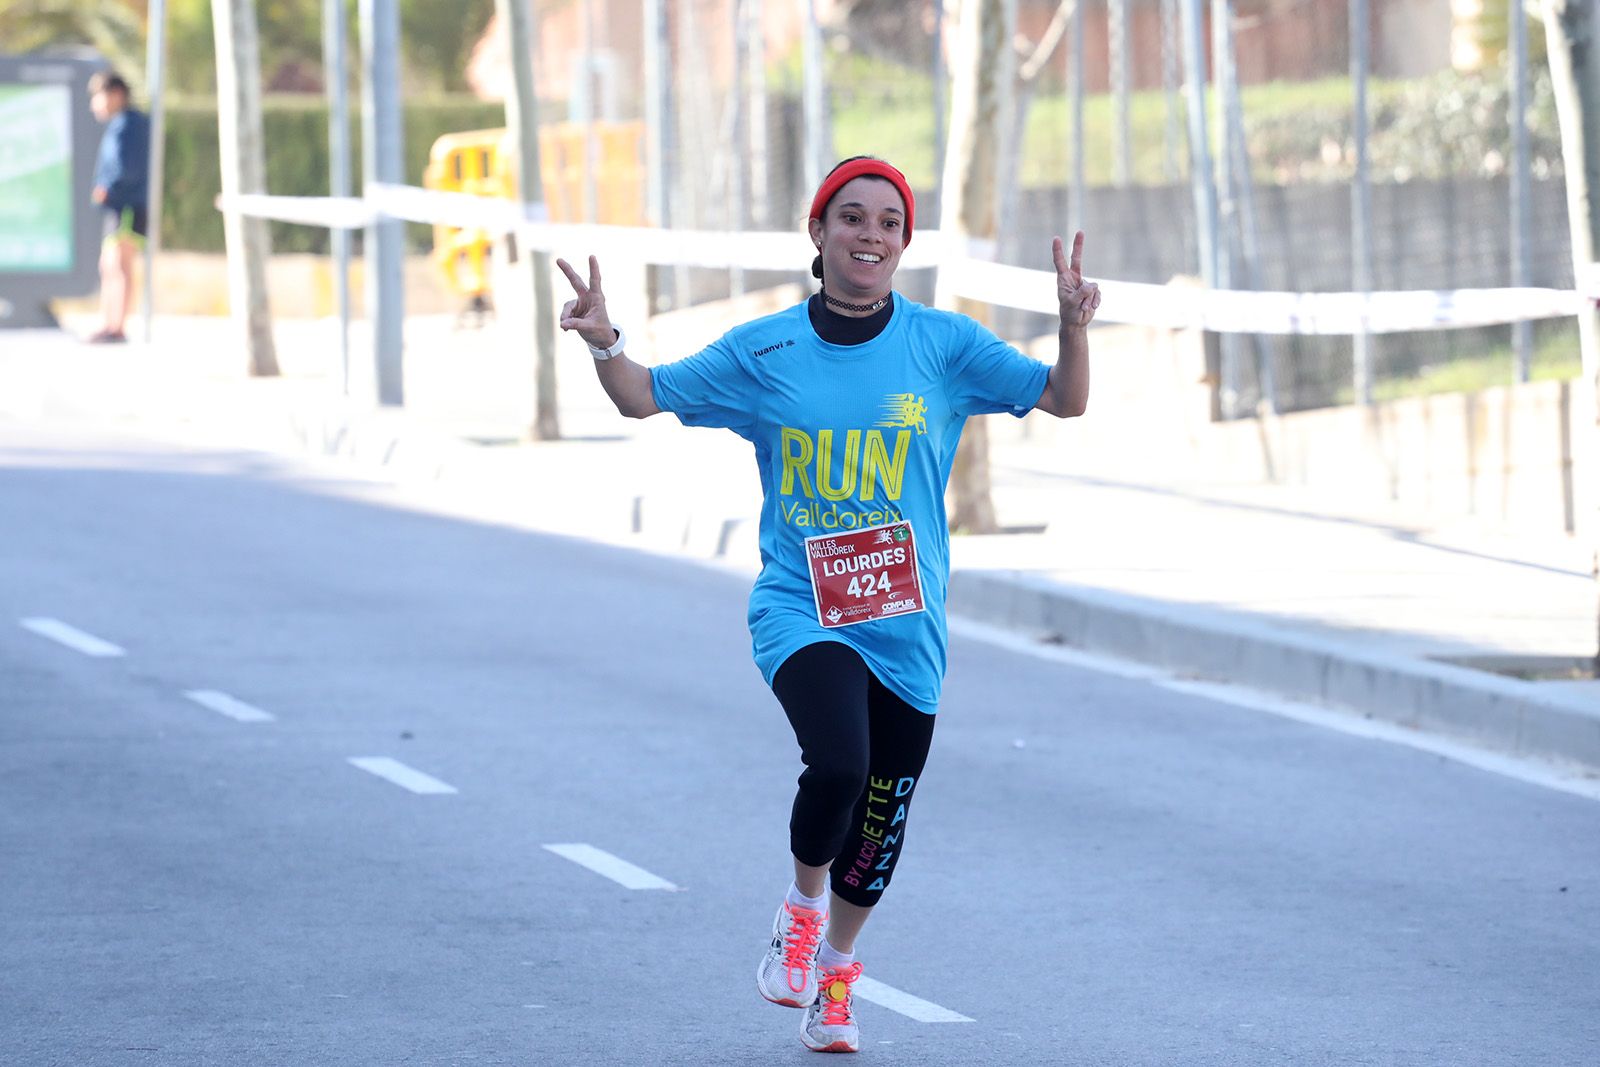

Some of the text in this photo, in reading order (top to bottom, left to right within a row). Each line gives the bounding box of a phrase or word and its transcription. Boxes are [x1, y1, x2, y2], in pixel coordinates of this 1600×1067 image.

[780, 426, 912, 502] RUN
[780, 500, 901, 529] Valldoreix
[809, 539, 837, 552] MILLES
[809, 544, 856, 559] VALLDOREIX
[823, 547, 906, 577] LOURDES
[847, 570, 892, 598] 424
[843, 866, 863, 888] BY
